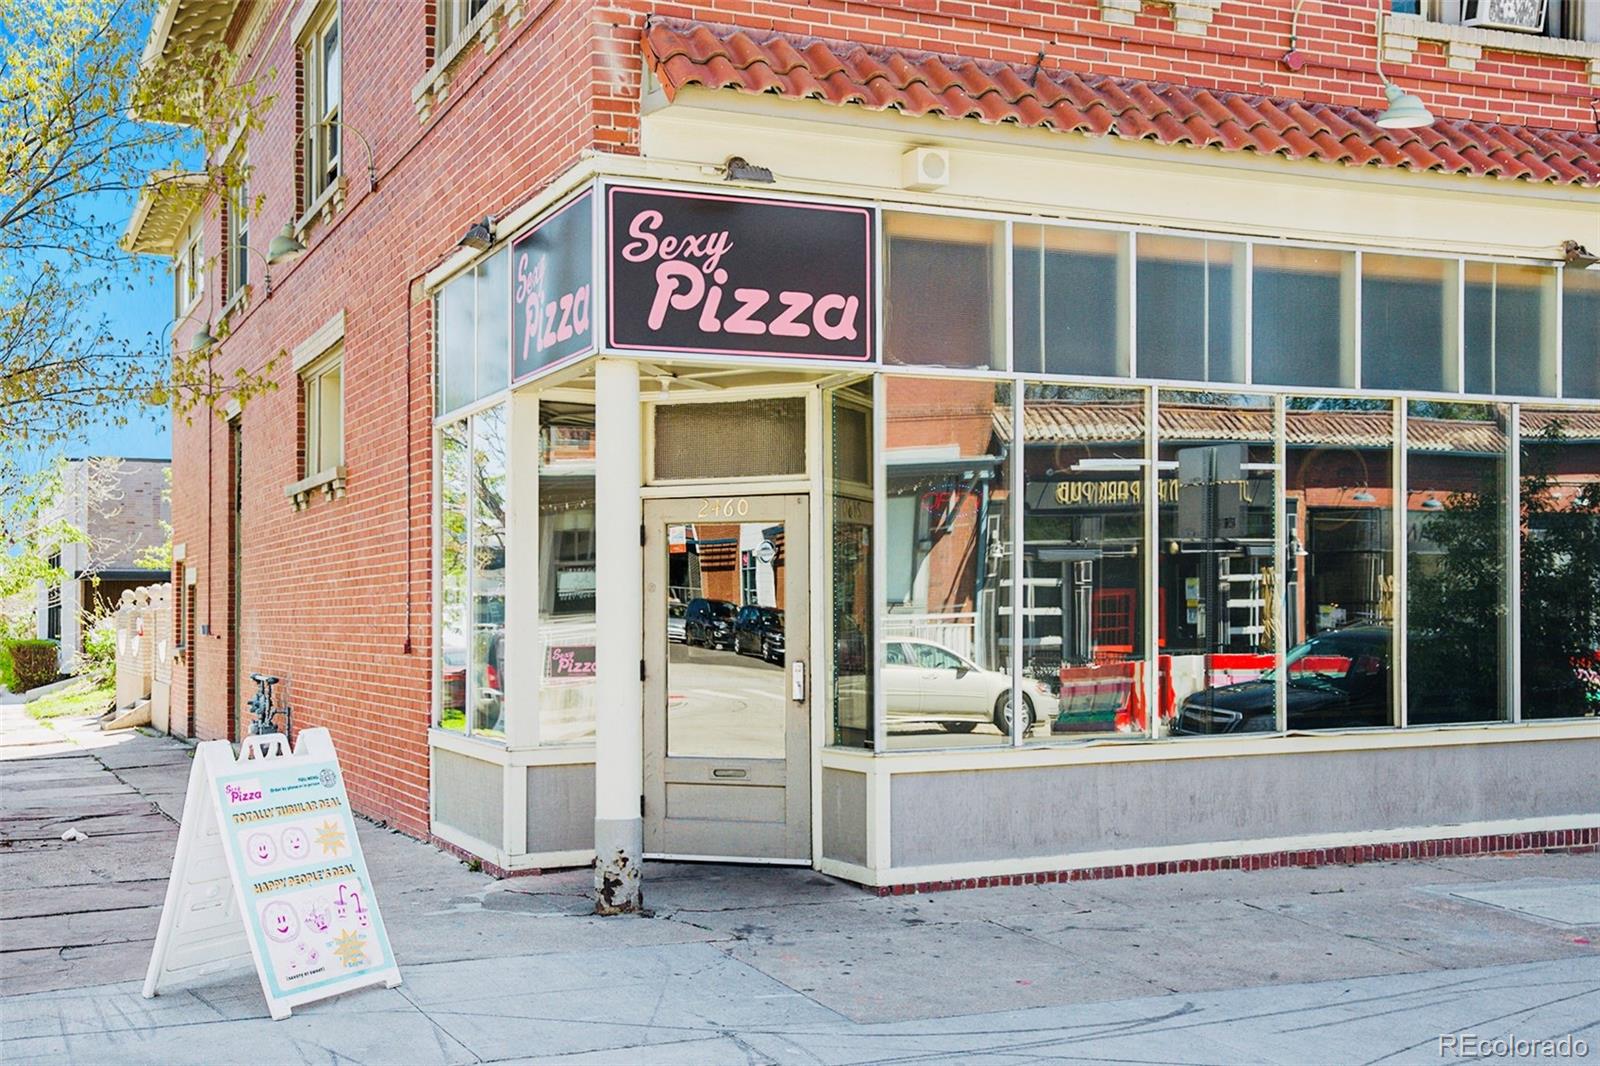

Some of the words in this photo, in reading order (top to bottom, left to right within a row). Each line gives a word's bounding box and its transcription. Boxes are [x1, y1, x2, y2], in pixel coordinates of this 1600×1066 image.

[622, 210, 734, 275] Sexy
[517, 253, 546, 304] Sexy
[647, 259, 859, 341] Pizza
[523, 284, 590, 360] Pizza
[231, 791, 262, 802] Pizza
[232, 807, 275, 825] TOTALLY
